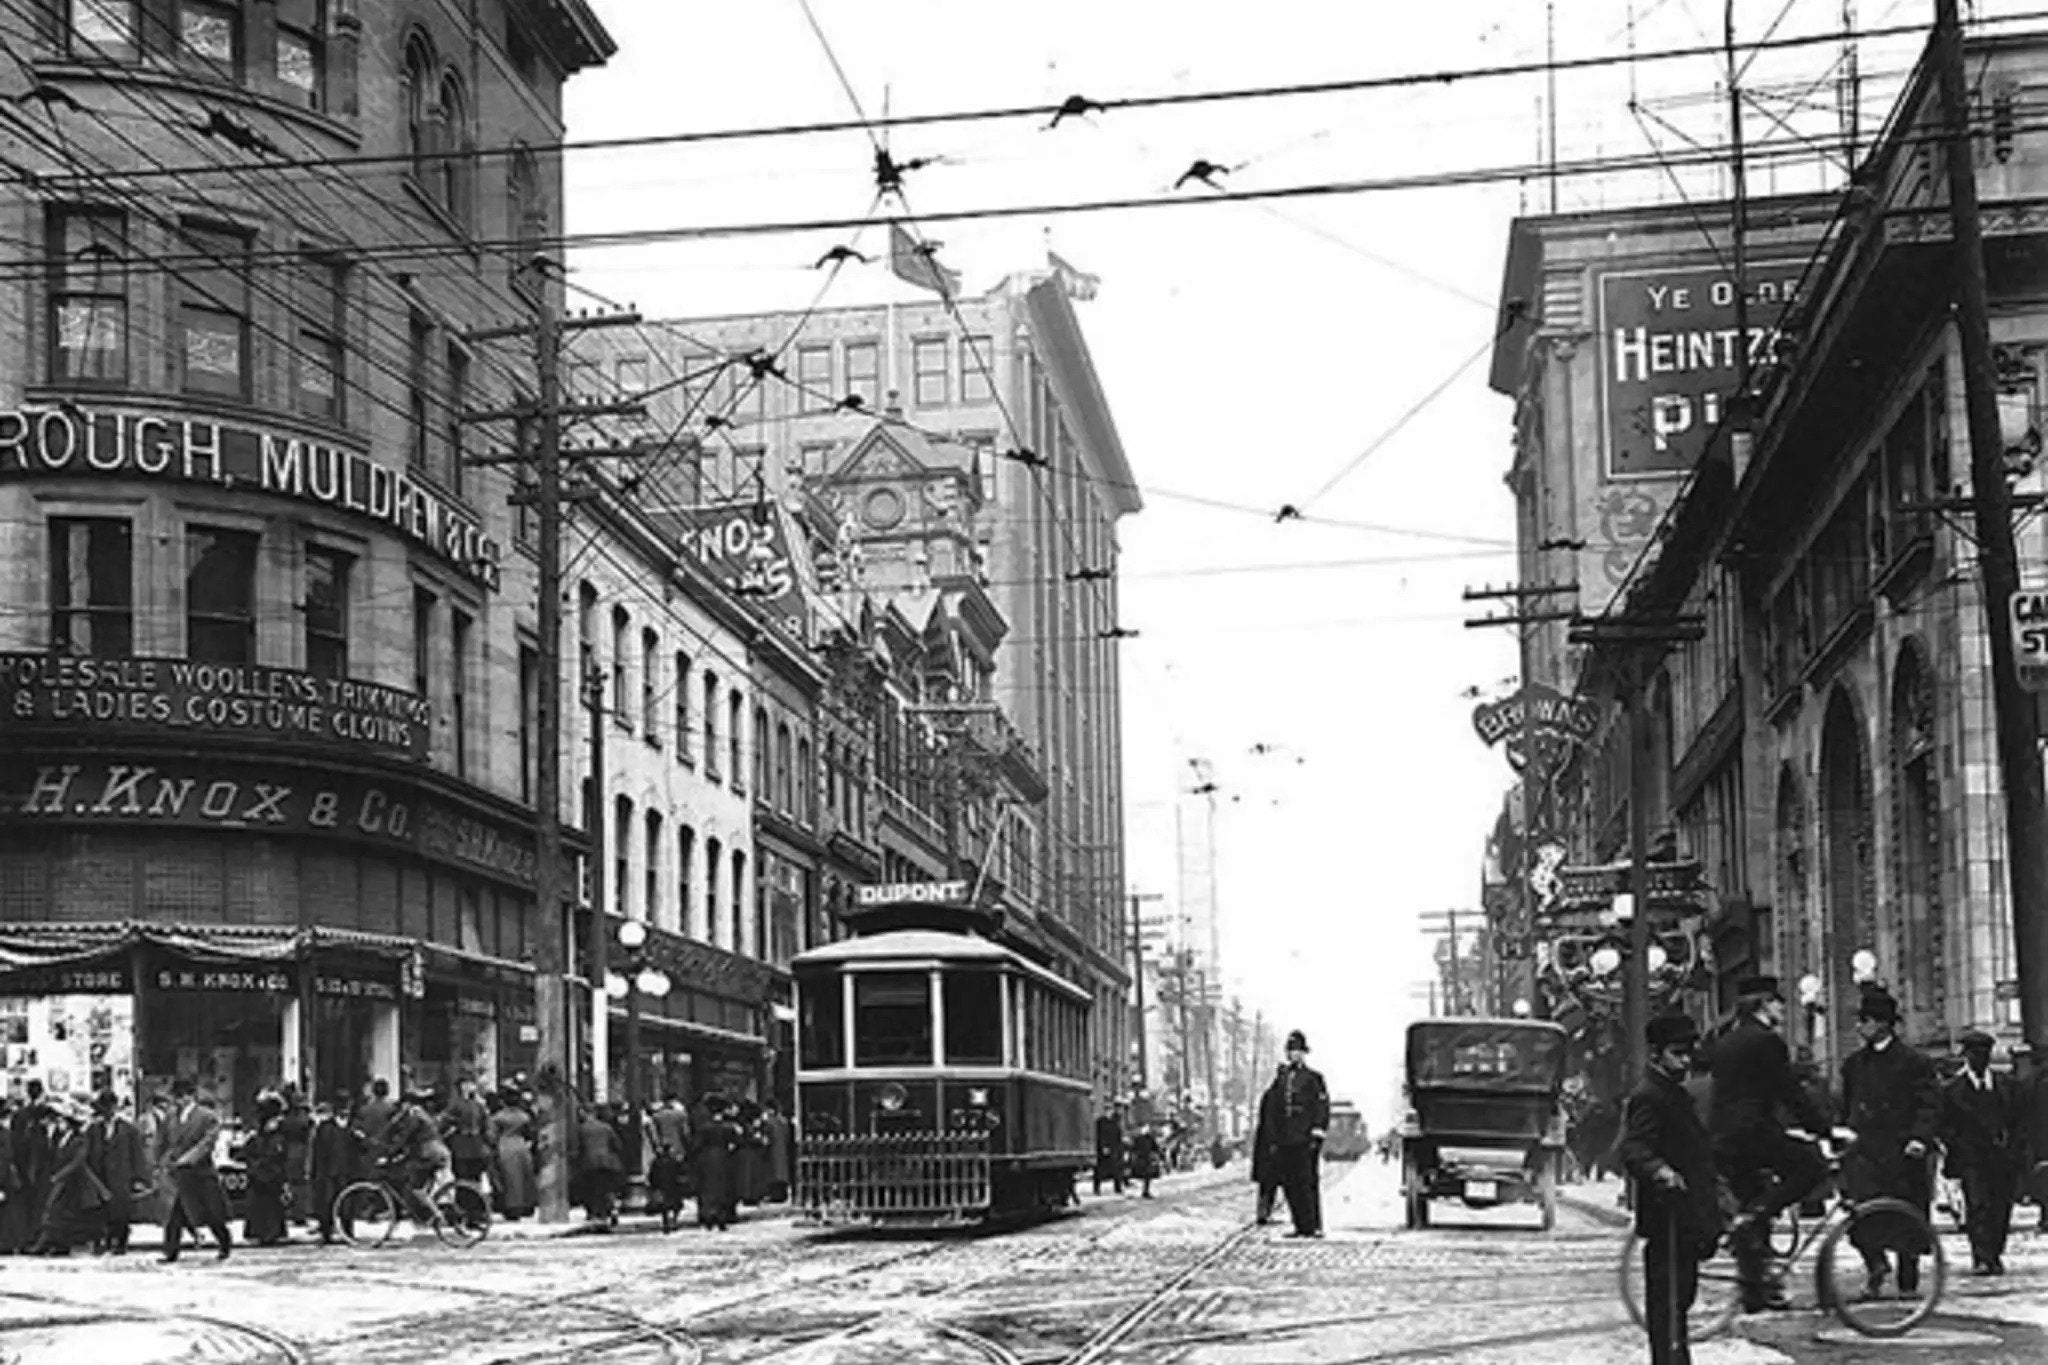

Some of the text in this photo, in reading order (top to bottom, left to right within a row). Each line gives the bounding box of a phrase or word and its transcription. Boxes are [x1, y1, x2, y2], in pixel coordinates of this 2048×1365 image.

[1648, 279, 1800, 309] YE ODE
[1613, 325, 1784, 382] HEINTZ
[308, 792, 338, 828] &
[860, 879, 968, 905] DUPONT
